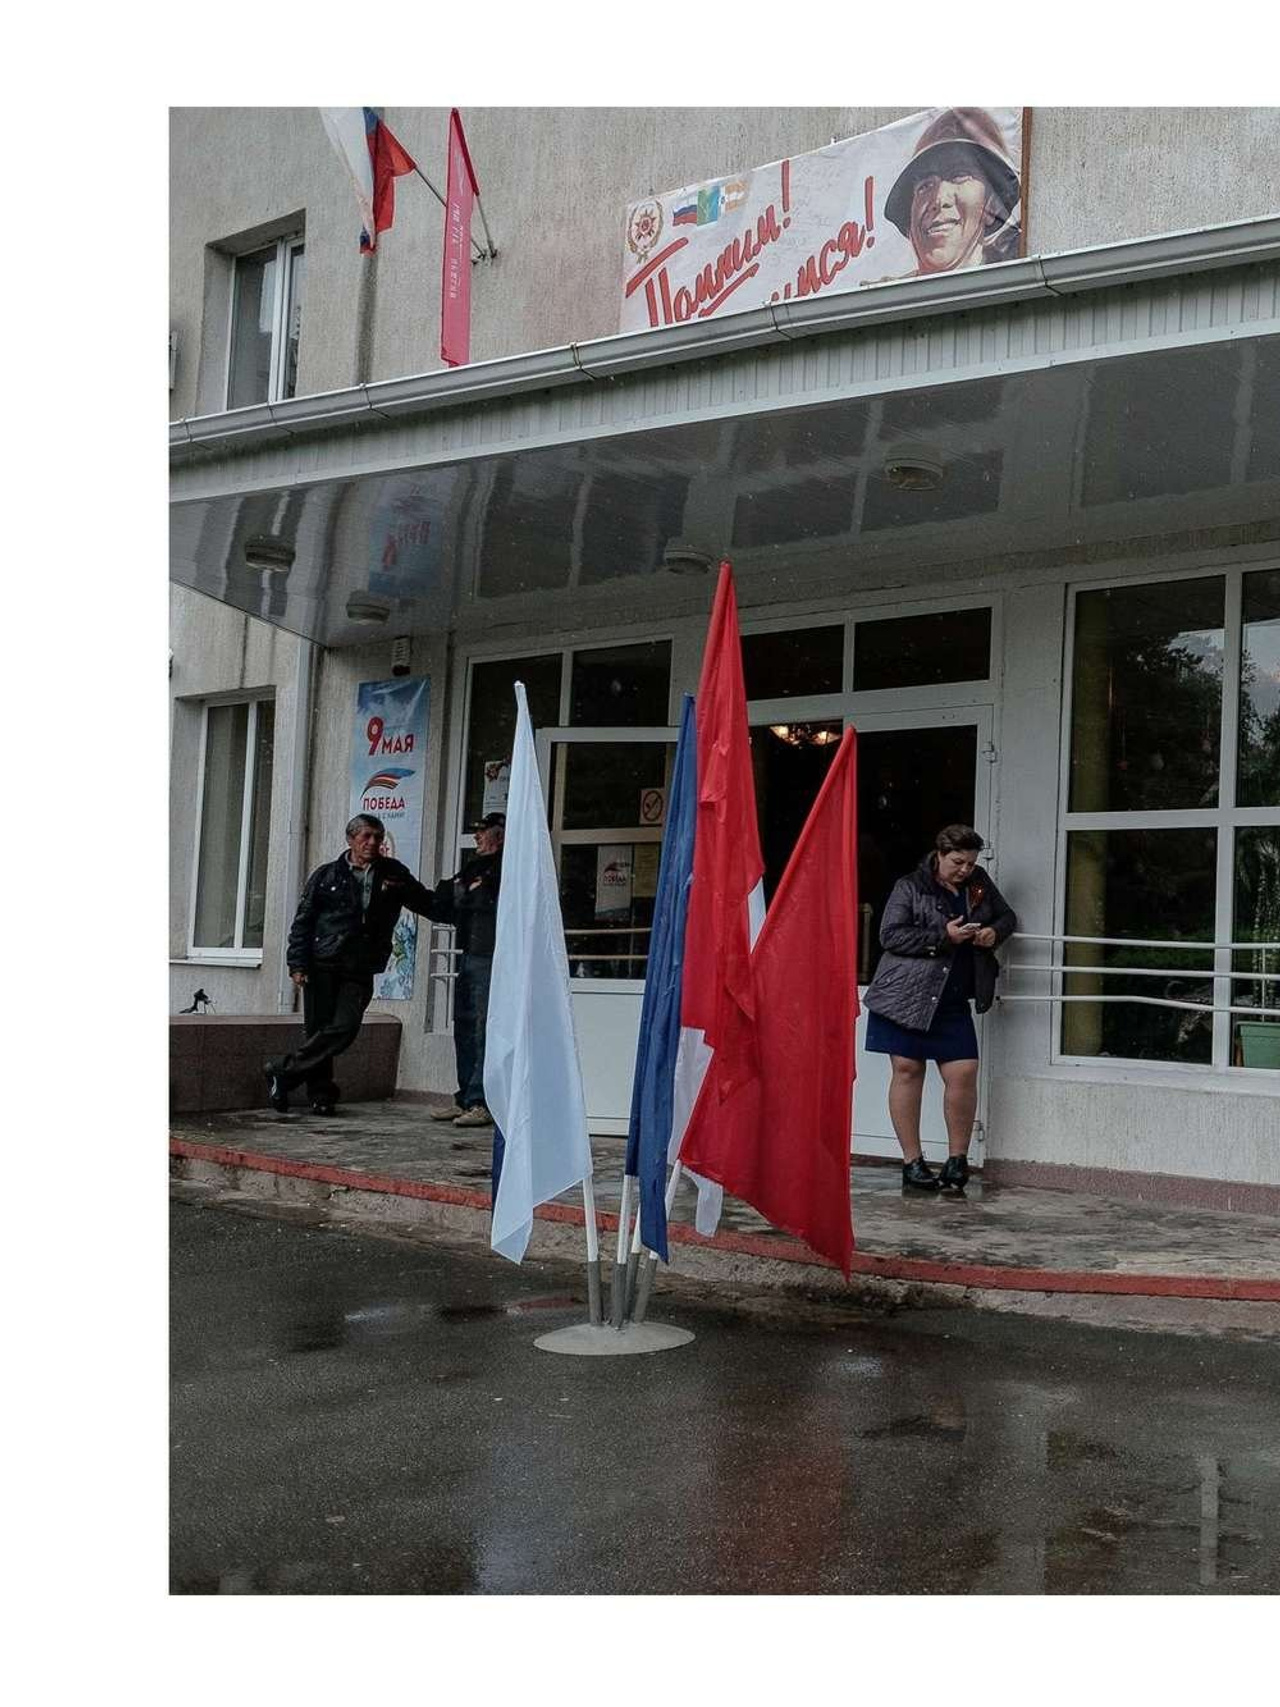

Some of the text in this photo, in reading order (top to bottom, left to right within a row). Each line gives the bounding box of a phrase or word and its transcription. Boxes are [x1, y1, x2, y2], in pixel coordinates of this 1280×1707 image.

[626, 160, 791, 327] Помним!
[771, 176, 875, 301] мся!
[367, 716, 414, 756] 9 МАЯ
[363, 796, 406, 811] ПОБЕДА
